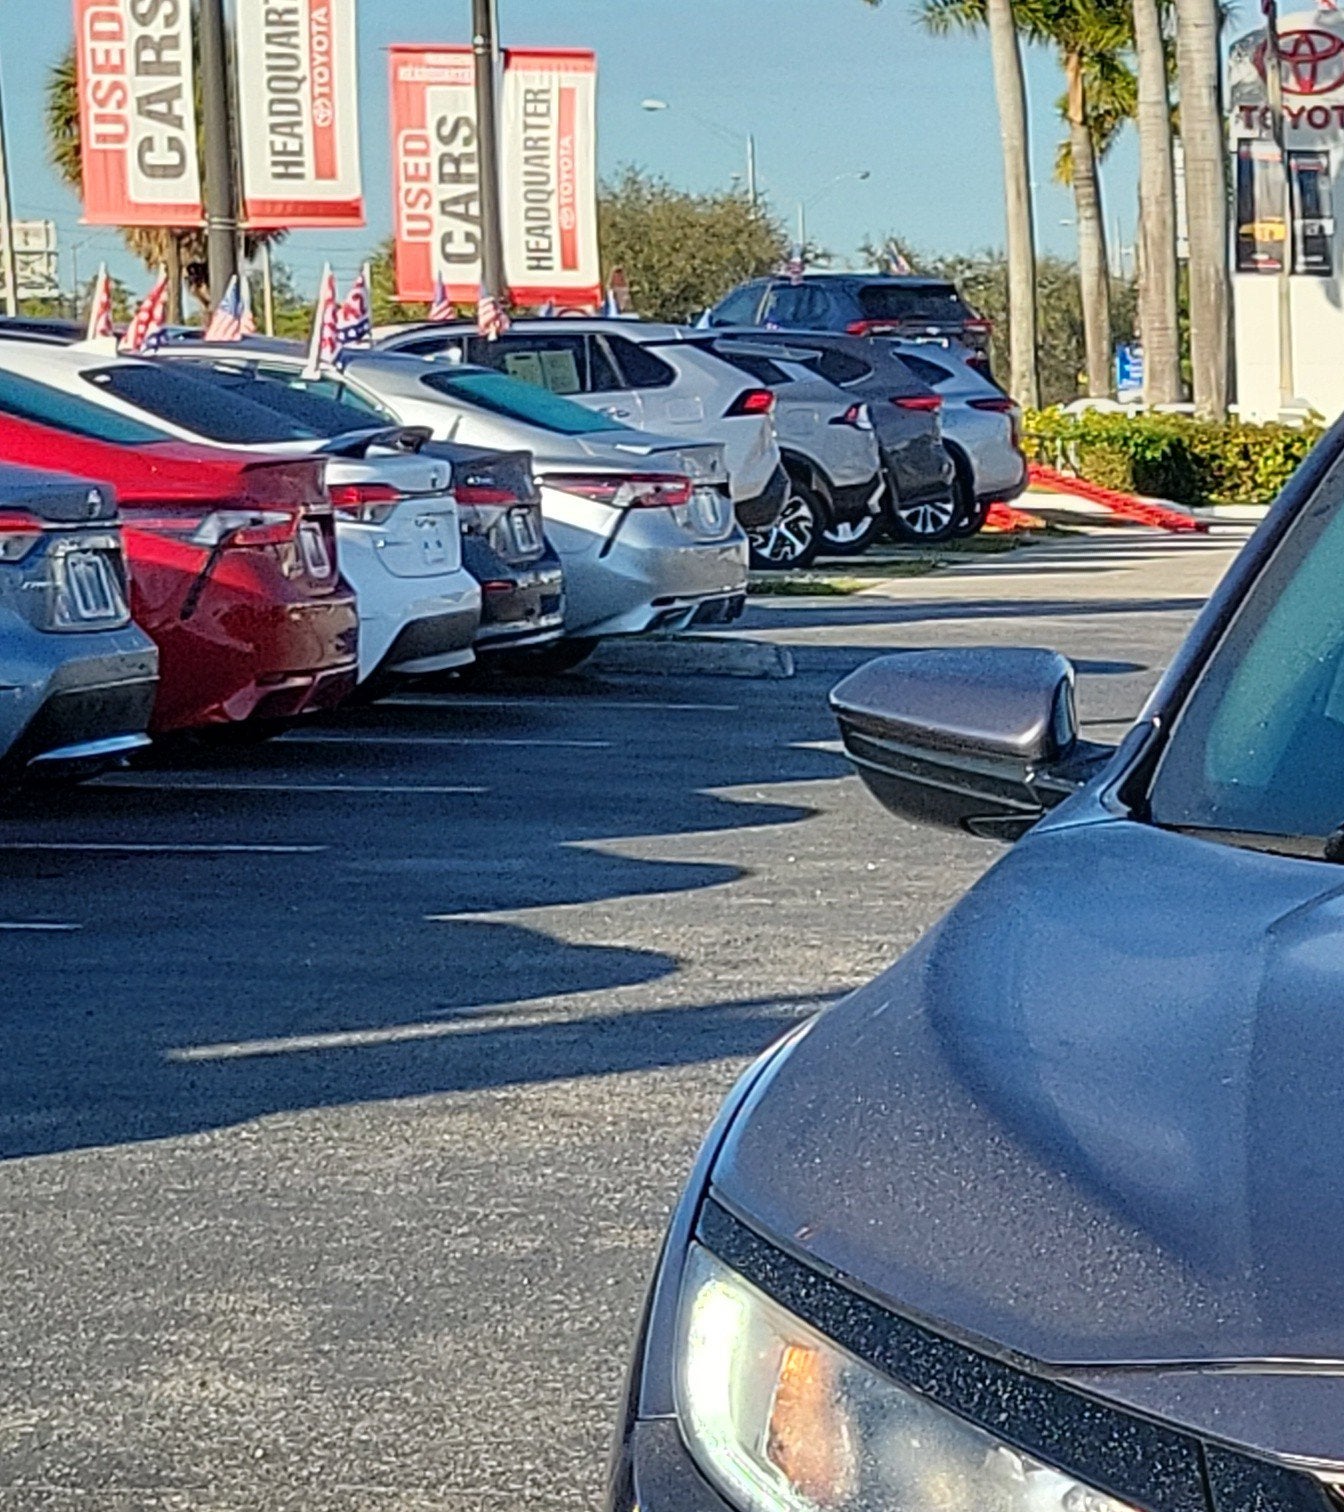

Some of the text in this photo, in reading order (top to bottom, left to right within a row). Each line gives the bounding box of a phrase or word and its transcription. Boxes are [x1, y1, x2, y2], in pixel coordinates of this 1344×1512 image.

[88, 9, 130, 146] USED
[132, 0, 187, 180] CARS
[264, 0, 307, 181] HEADQUAR
[310, 6, 330, 92] TOYOTA
[402, 132, 433, 238] USED
[436, 115, 482, 265] CARS
[523, 88, 554, 272] HEADQUARTER
[559, 135, 574, 206] TOYOTA
